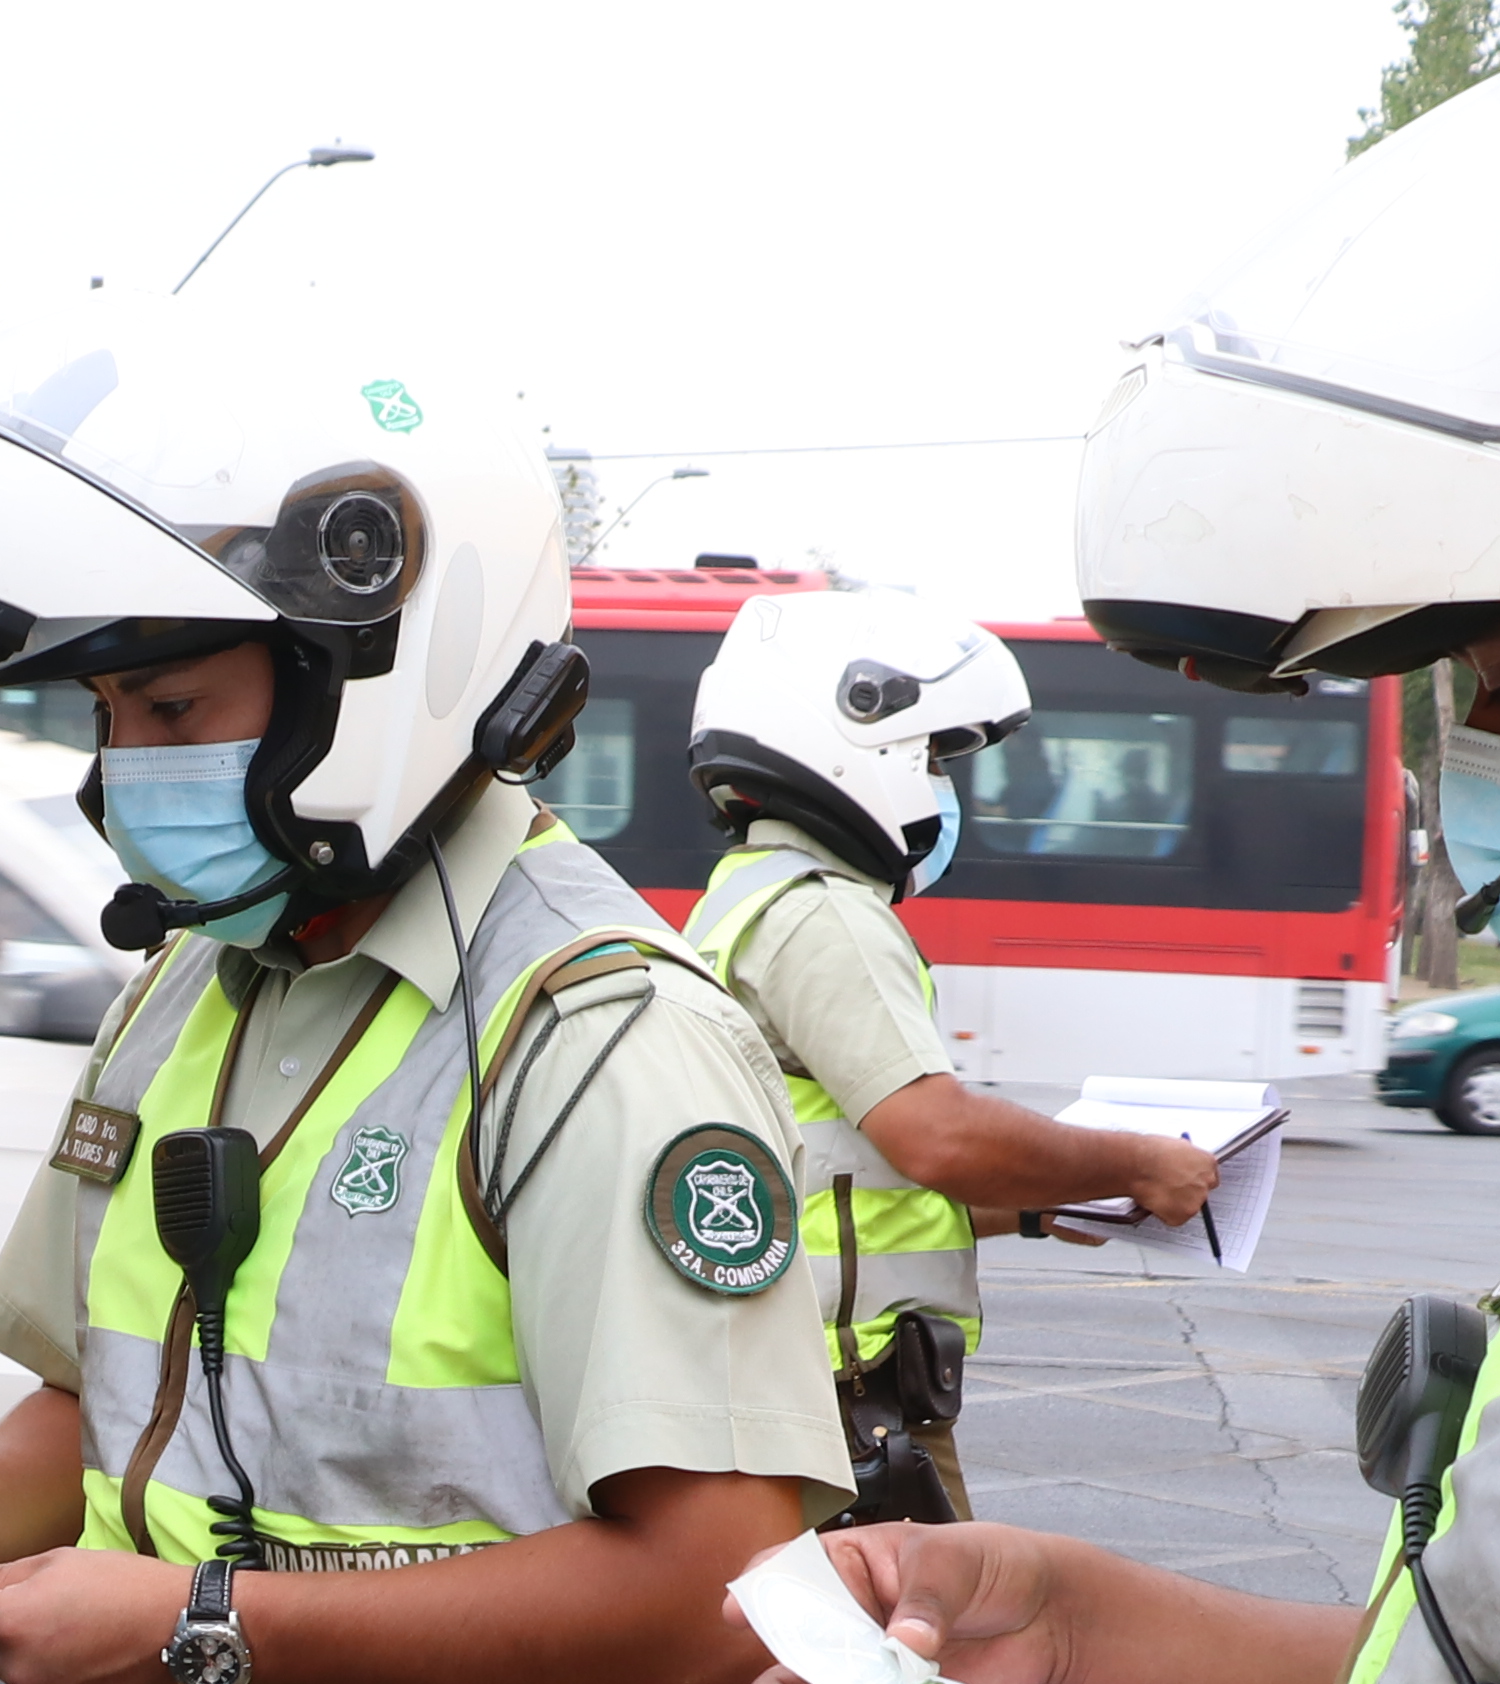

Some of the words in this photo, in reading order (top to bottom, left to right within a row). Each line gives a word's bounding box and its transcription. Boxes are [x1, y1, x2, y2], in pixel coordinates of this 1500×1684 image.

[75, 1112, 99, 1136] CABO
[71, 1138, 104, 1164] FLORES
[671, 1240, 706, 1278] 32A.
[714, 1238, 789, 1286] COMISARIA
